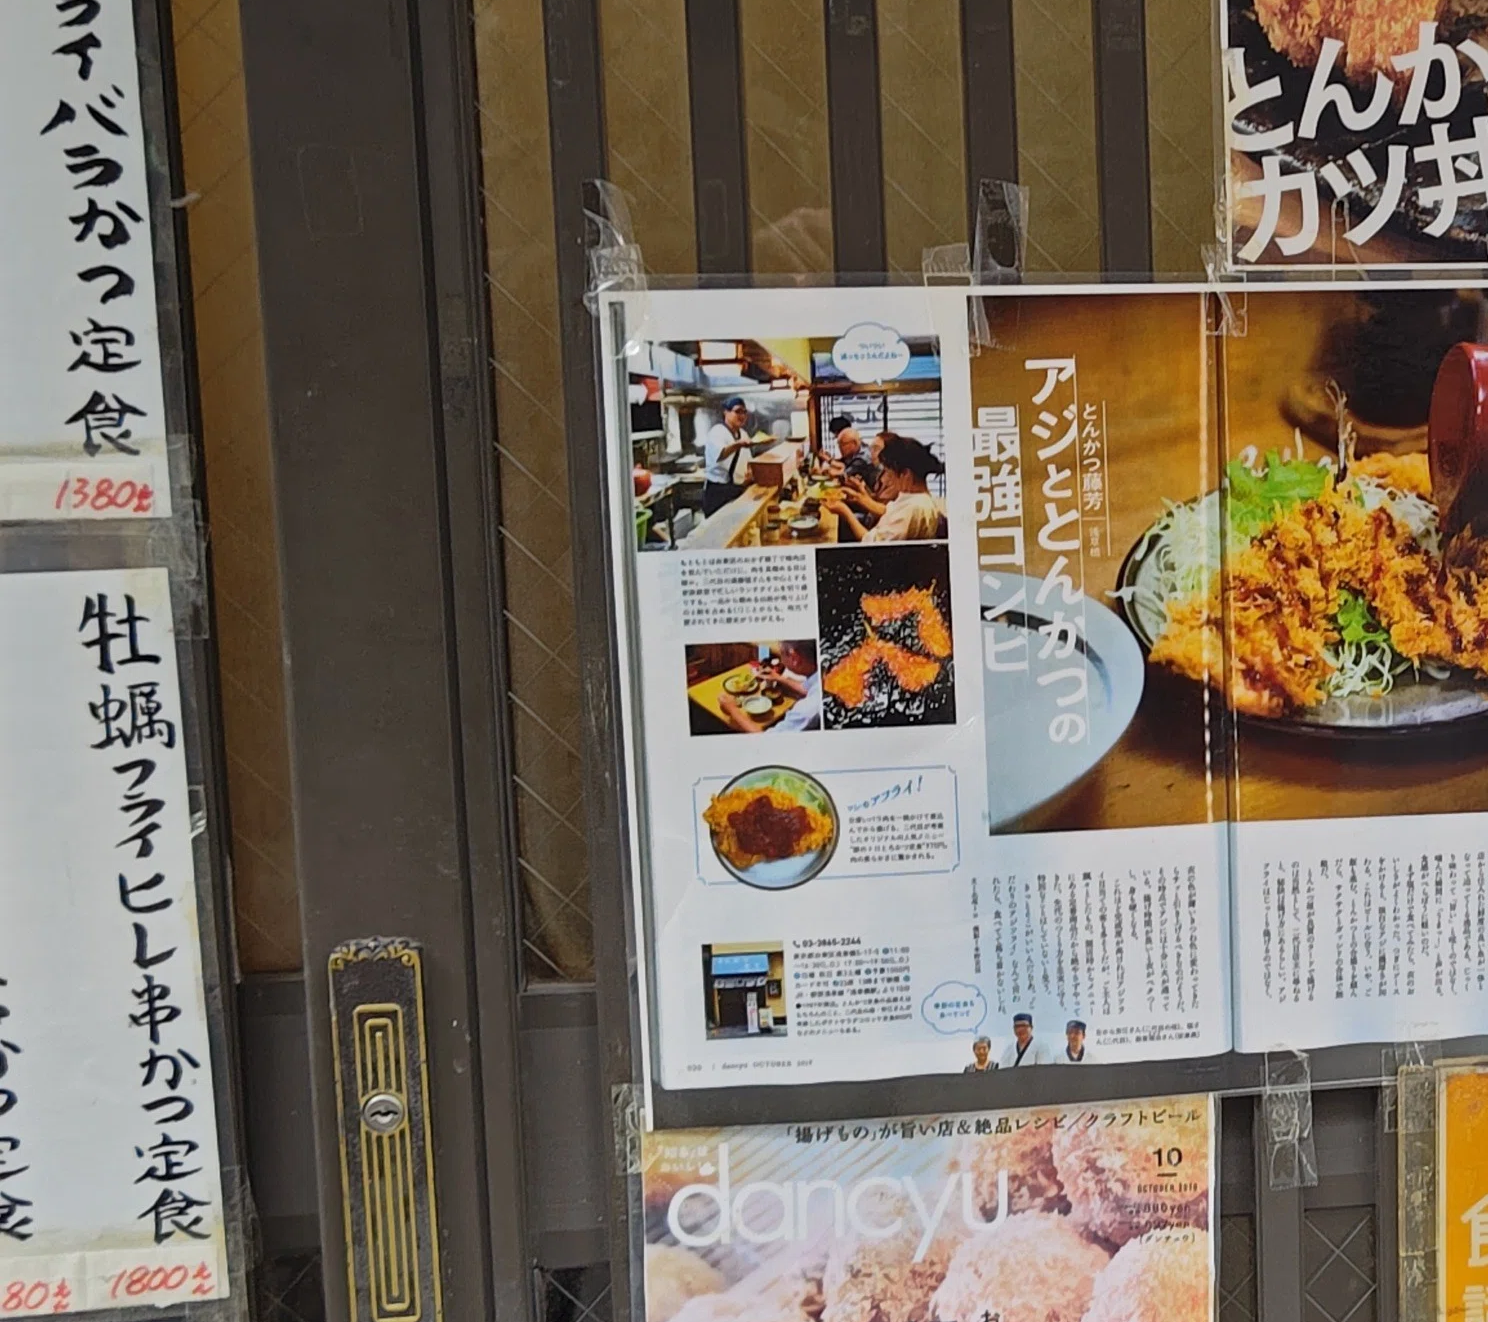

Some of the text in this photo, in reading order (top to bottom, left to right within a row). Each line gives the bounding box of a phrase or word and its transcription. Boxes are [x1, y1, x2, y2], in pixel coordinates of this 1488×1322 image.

[1081, 402, 1102, 511] とんかつ藤芳
[973, 406, 1028, 673] 最強コンビ
[1025, 357, 1088, 745] アジととんかつの
[667, 1142, 1008, 1262] dancyu
[1152, 1147, 1183, 1167] 10
